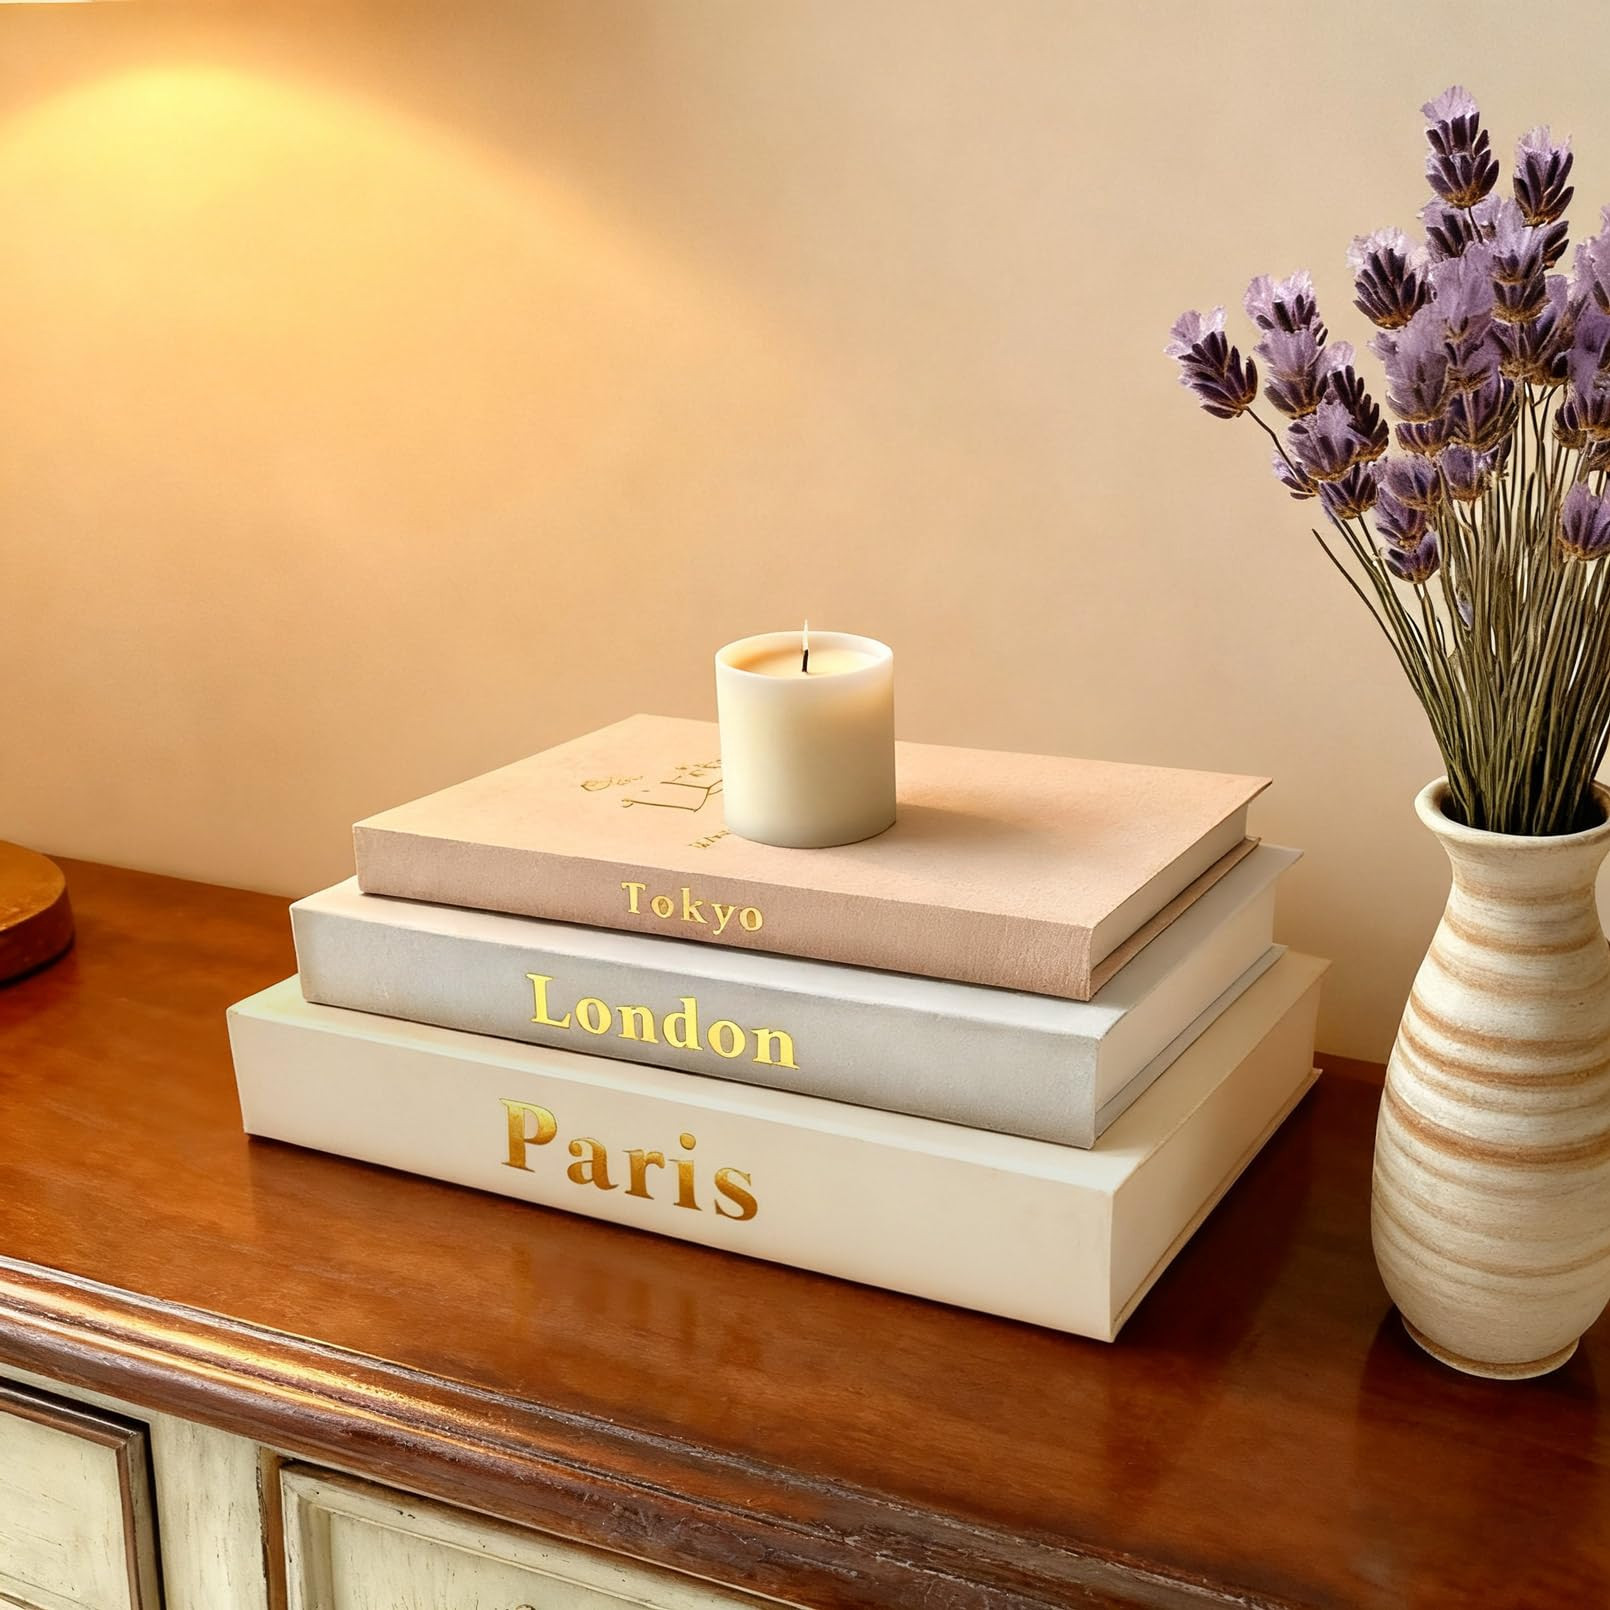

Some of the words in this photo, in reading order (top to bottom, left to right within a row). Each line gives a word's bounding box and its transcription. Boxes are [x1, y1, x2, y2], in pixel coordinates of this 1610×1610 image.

[621, 881, 764, 935] Tokyo
[526, 973, 800, 1070] London
[499, 1098, 758, 1221] Paris
